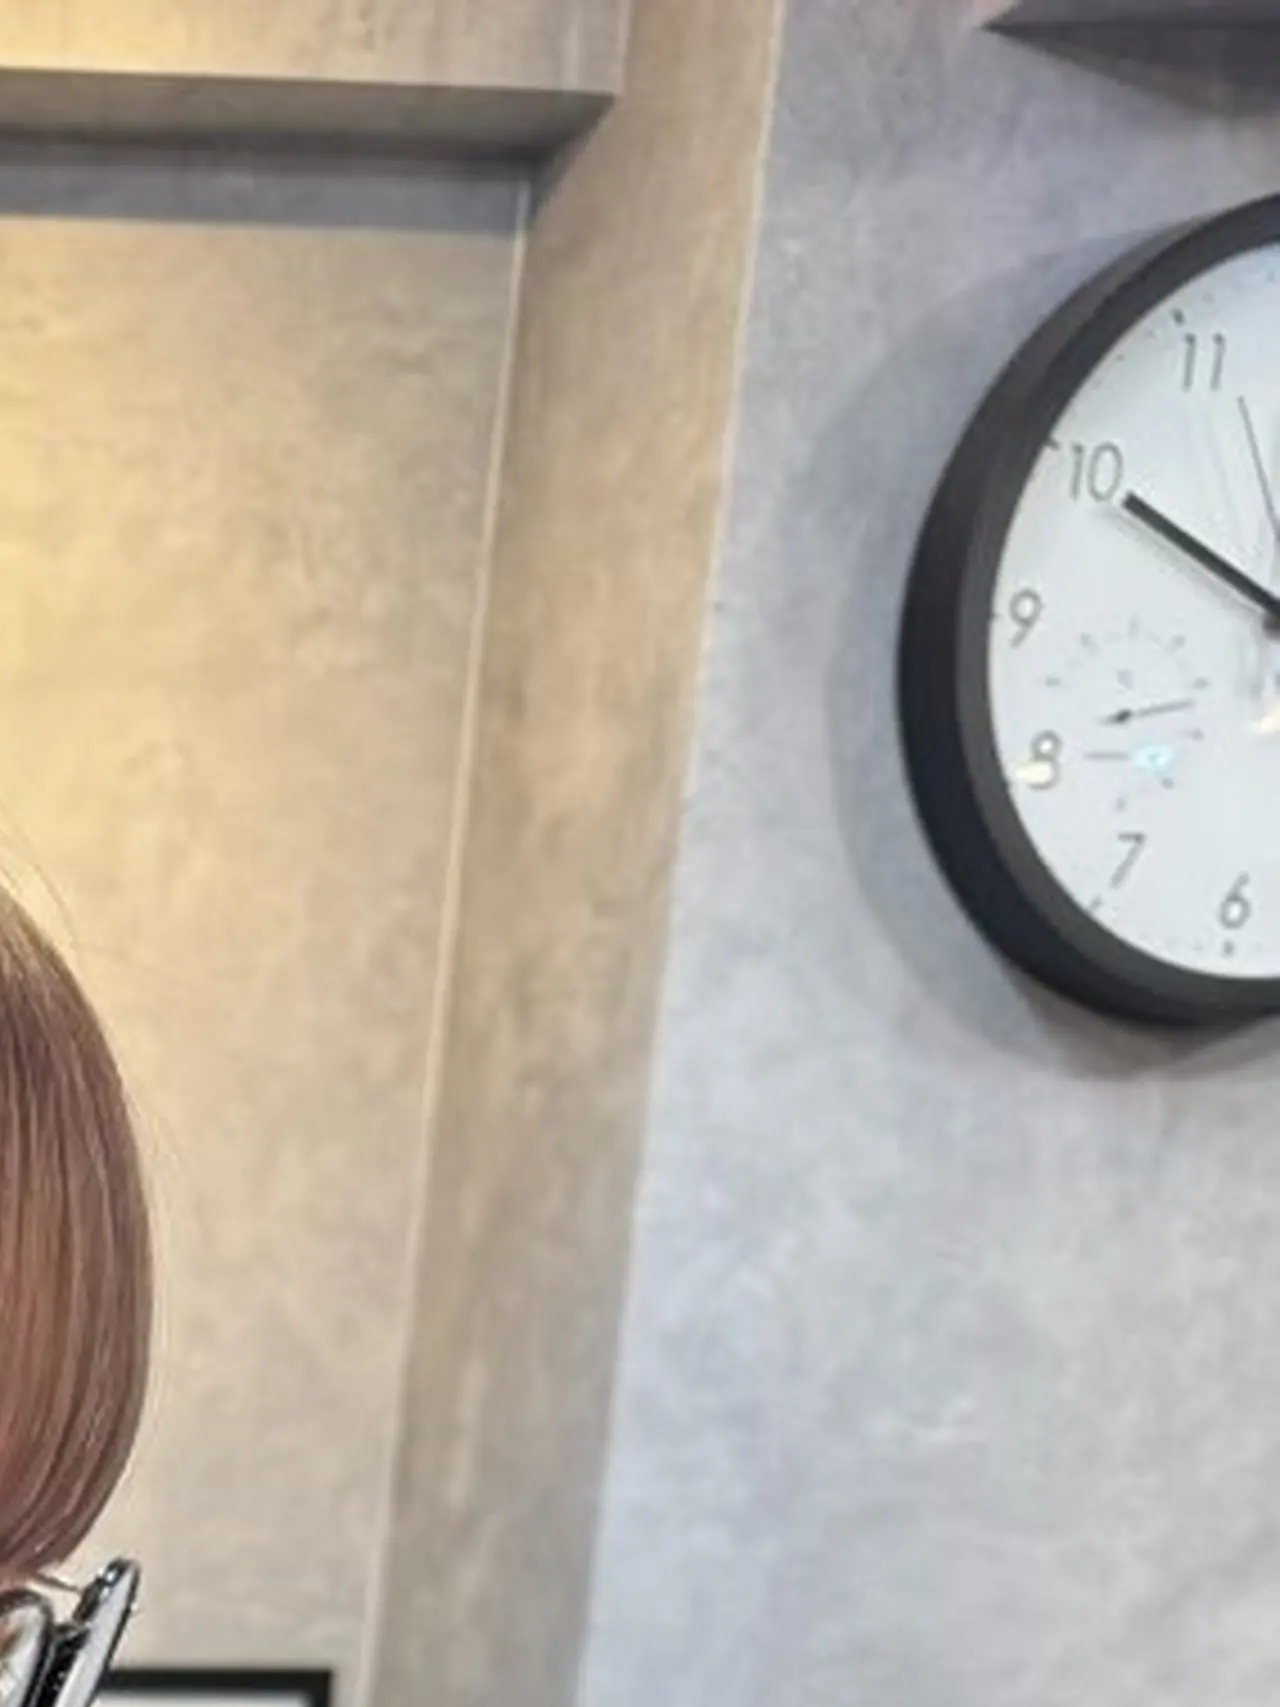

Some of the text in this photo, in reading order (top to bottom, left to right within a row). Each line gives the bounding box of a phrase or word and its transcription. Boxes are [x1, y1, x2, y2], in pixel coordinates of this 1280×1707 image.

[1182, 331, 1226, 391] 11
[1069, 441, 1124, 502] 10
[1008, 588, 1042, 648] 9
[1024, 729, 1062, 790] 8
[1109, 832, 1146, 890] 7
[1218, 870, 1250, 930] 6
